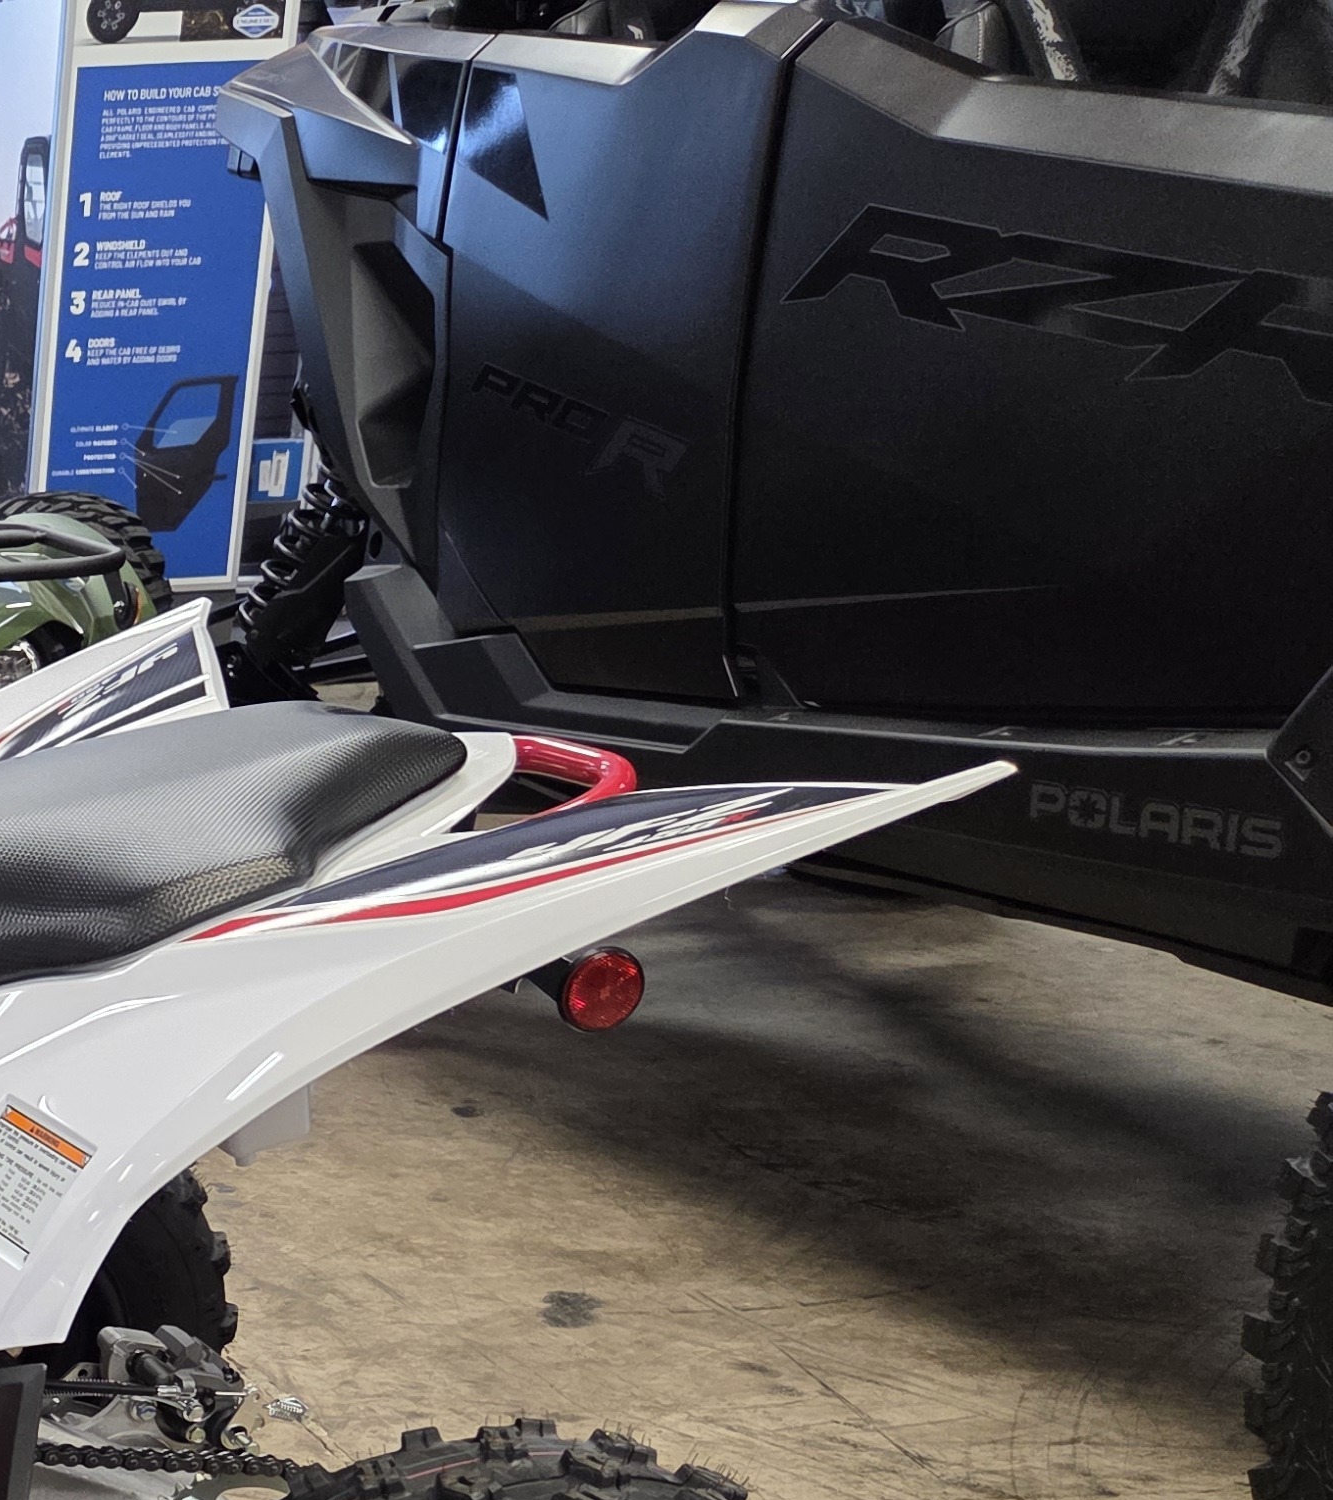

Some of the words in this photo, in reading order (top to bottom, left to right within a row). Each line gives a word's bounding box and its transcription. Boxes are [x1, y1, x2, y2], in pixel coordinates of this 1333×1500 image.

[104, 90, 125, 101] HOW
[128, 89, 138, 100] TO
[140, 88, 167, 100] BUILD
[169, 87, 192, 98] YOUR
[194, 86, 211, 97] CAB
[79, 192, 92, 217] 1
[100, 191, 122, 201] ROOF
[73, 242, 90, 266] 2
[96, 240, 145, 251] WINDSHIELD
[69, 291, 86, 315] 3
[92, 290, 114, 300] REAR
[115, 288, 142, 299] PANEL
[780, 202, 1333, 408] RZR
[65, 339, 82, 363] 4
[88, 338, 115, 348] DOORS
[470, 361, 610, 445] PRO
[584, 415, 690, 502] R
[1030, 780, 1283, 858] POLARIS
